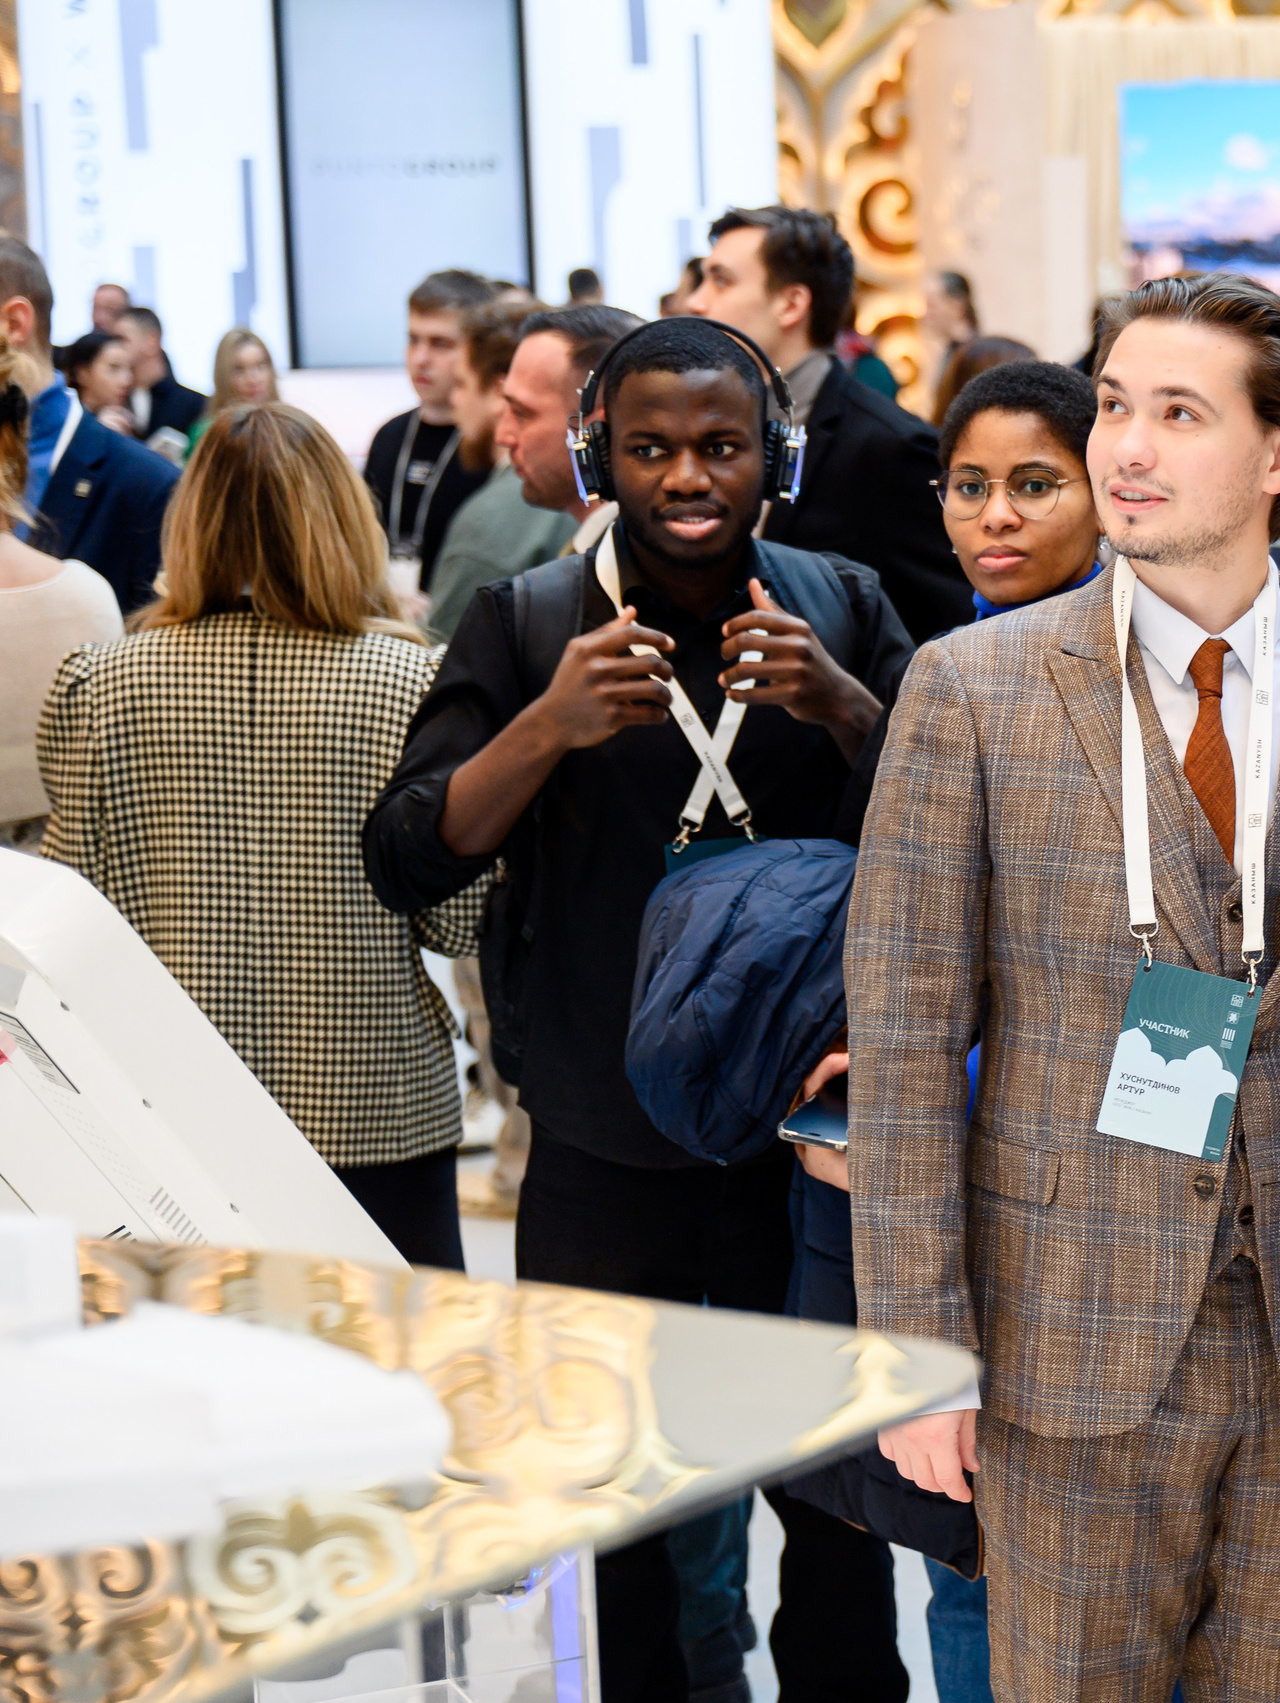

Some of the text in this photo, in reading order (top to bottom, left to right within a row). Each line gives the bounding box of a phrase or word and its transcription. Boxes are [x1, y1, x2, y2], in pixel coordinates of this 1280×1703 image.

[1139, 1018, 1190, 1039] УЧАСТНИК
[1116, 1083, 1145, 1095] АРТУР
[1120, 1072, 1181, 1095] ХУСНУТДИНОВ
